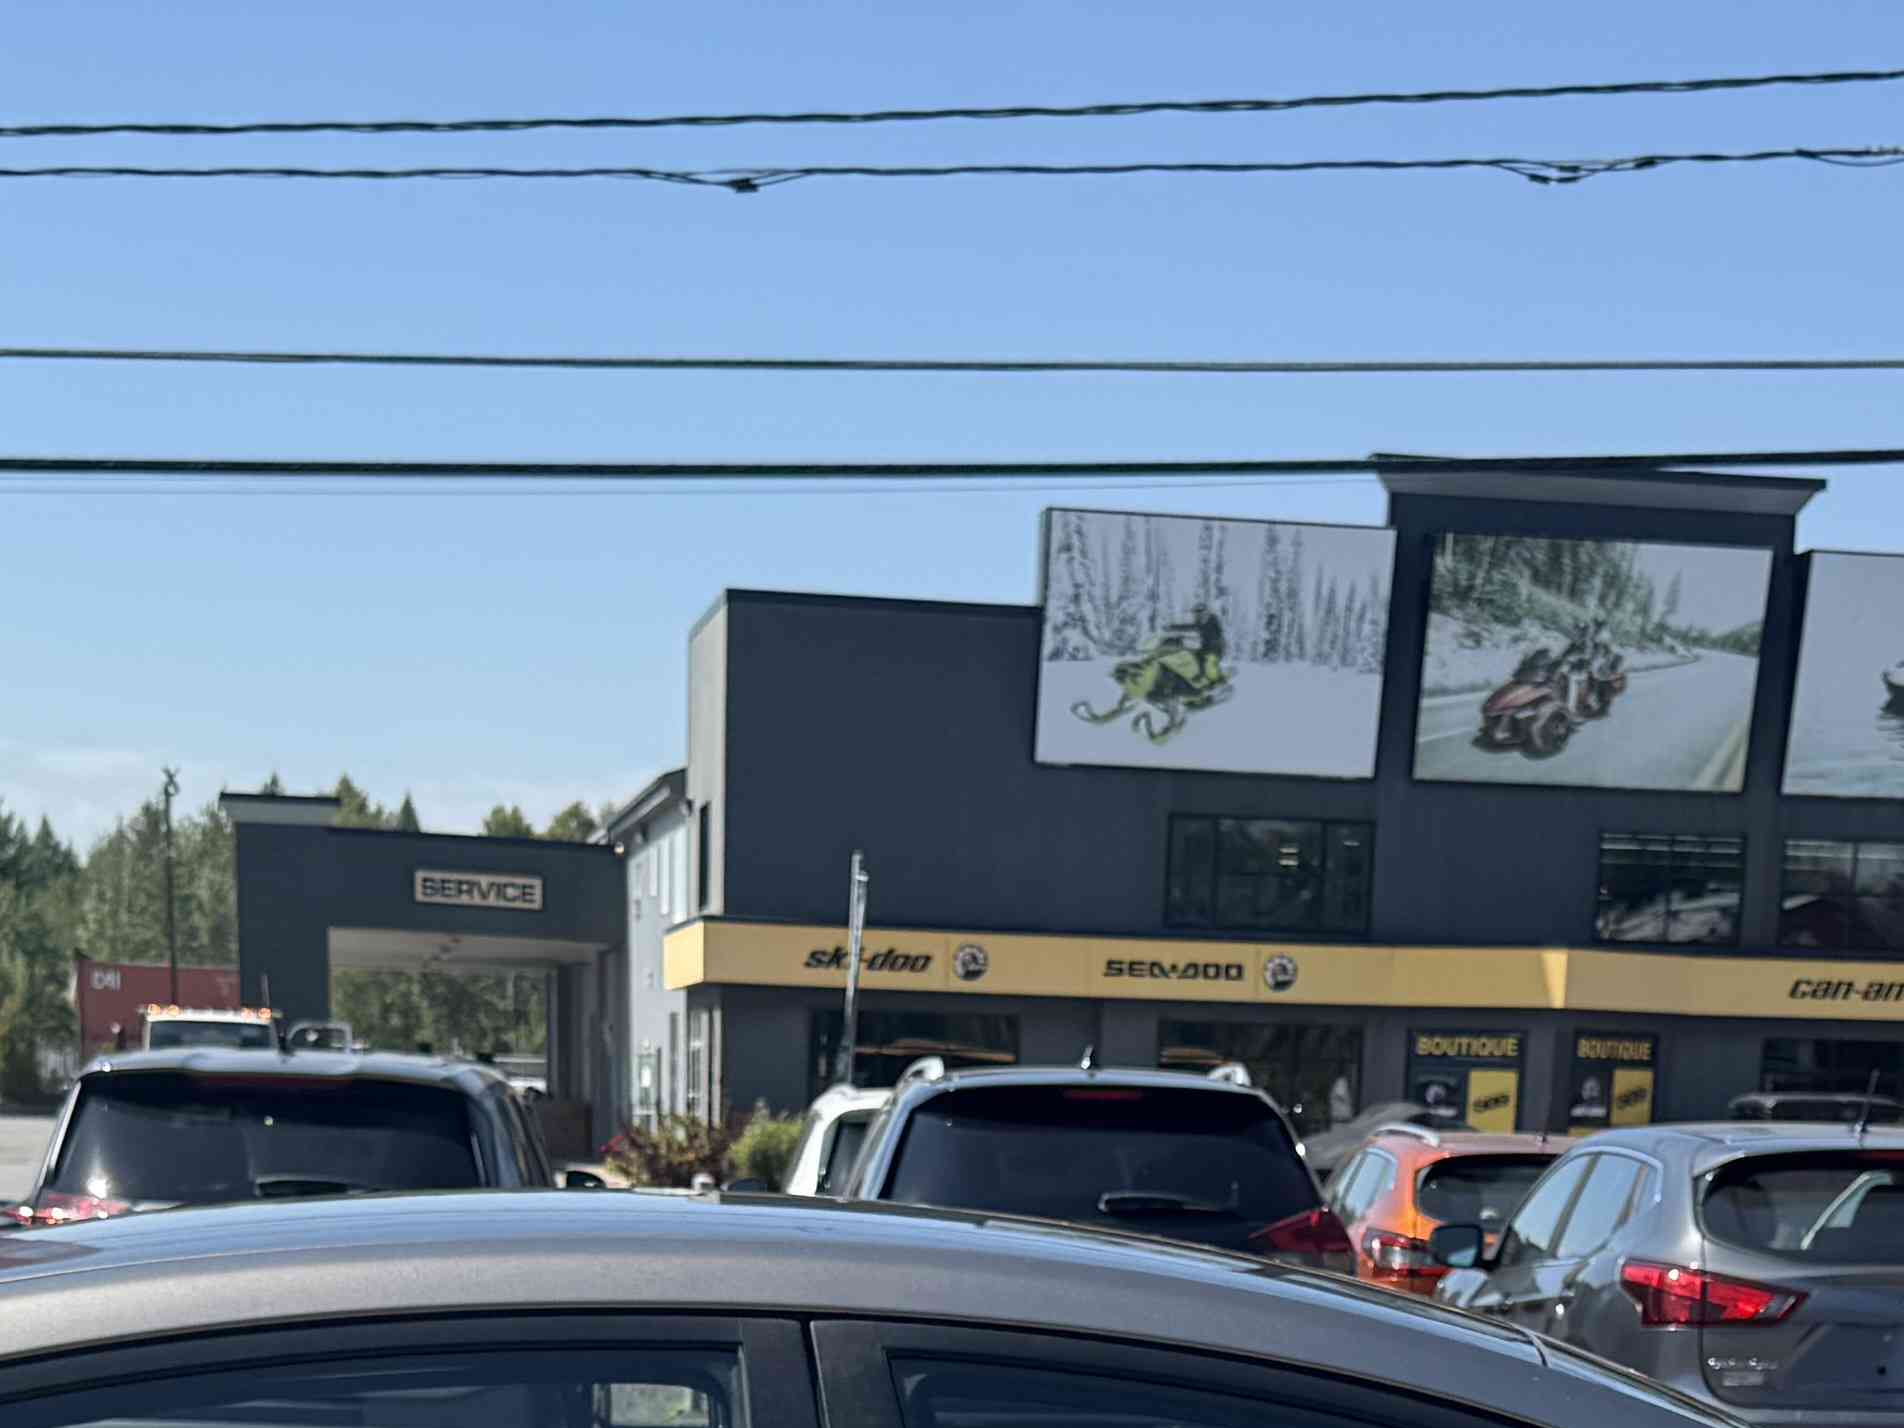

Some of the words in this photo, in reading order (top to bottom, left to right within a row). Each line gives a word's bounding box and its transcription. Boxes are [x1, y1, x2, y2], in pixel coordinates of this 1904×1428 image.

[422, 877, 537, 903] SERVICE
[803, 945, 934, 973] sk-doo
[1417, 1036, 1520, 1058] BOUTIQUE
[1577, 1038, 1652, 1061] BOUTIQUE
